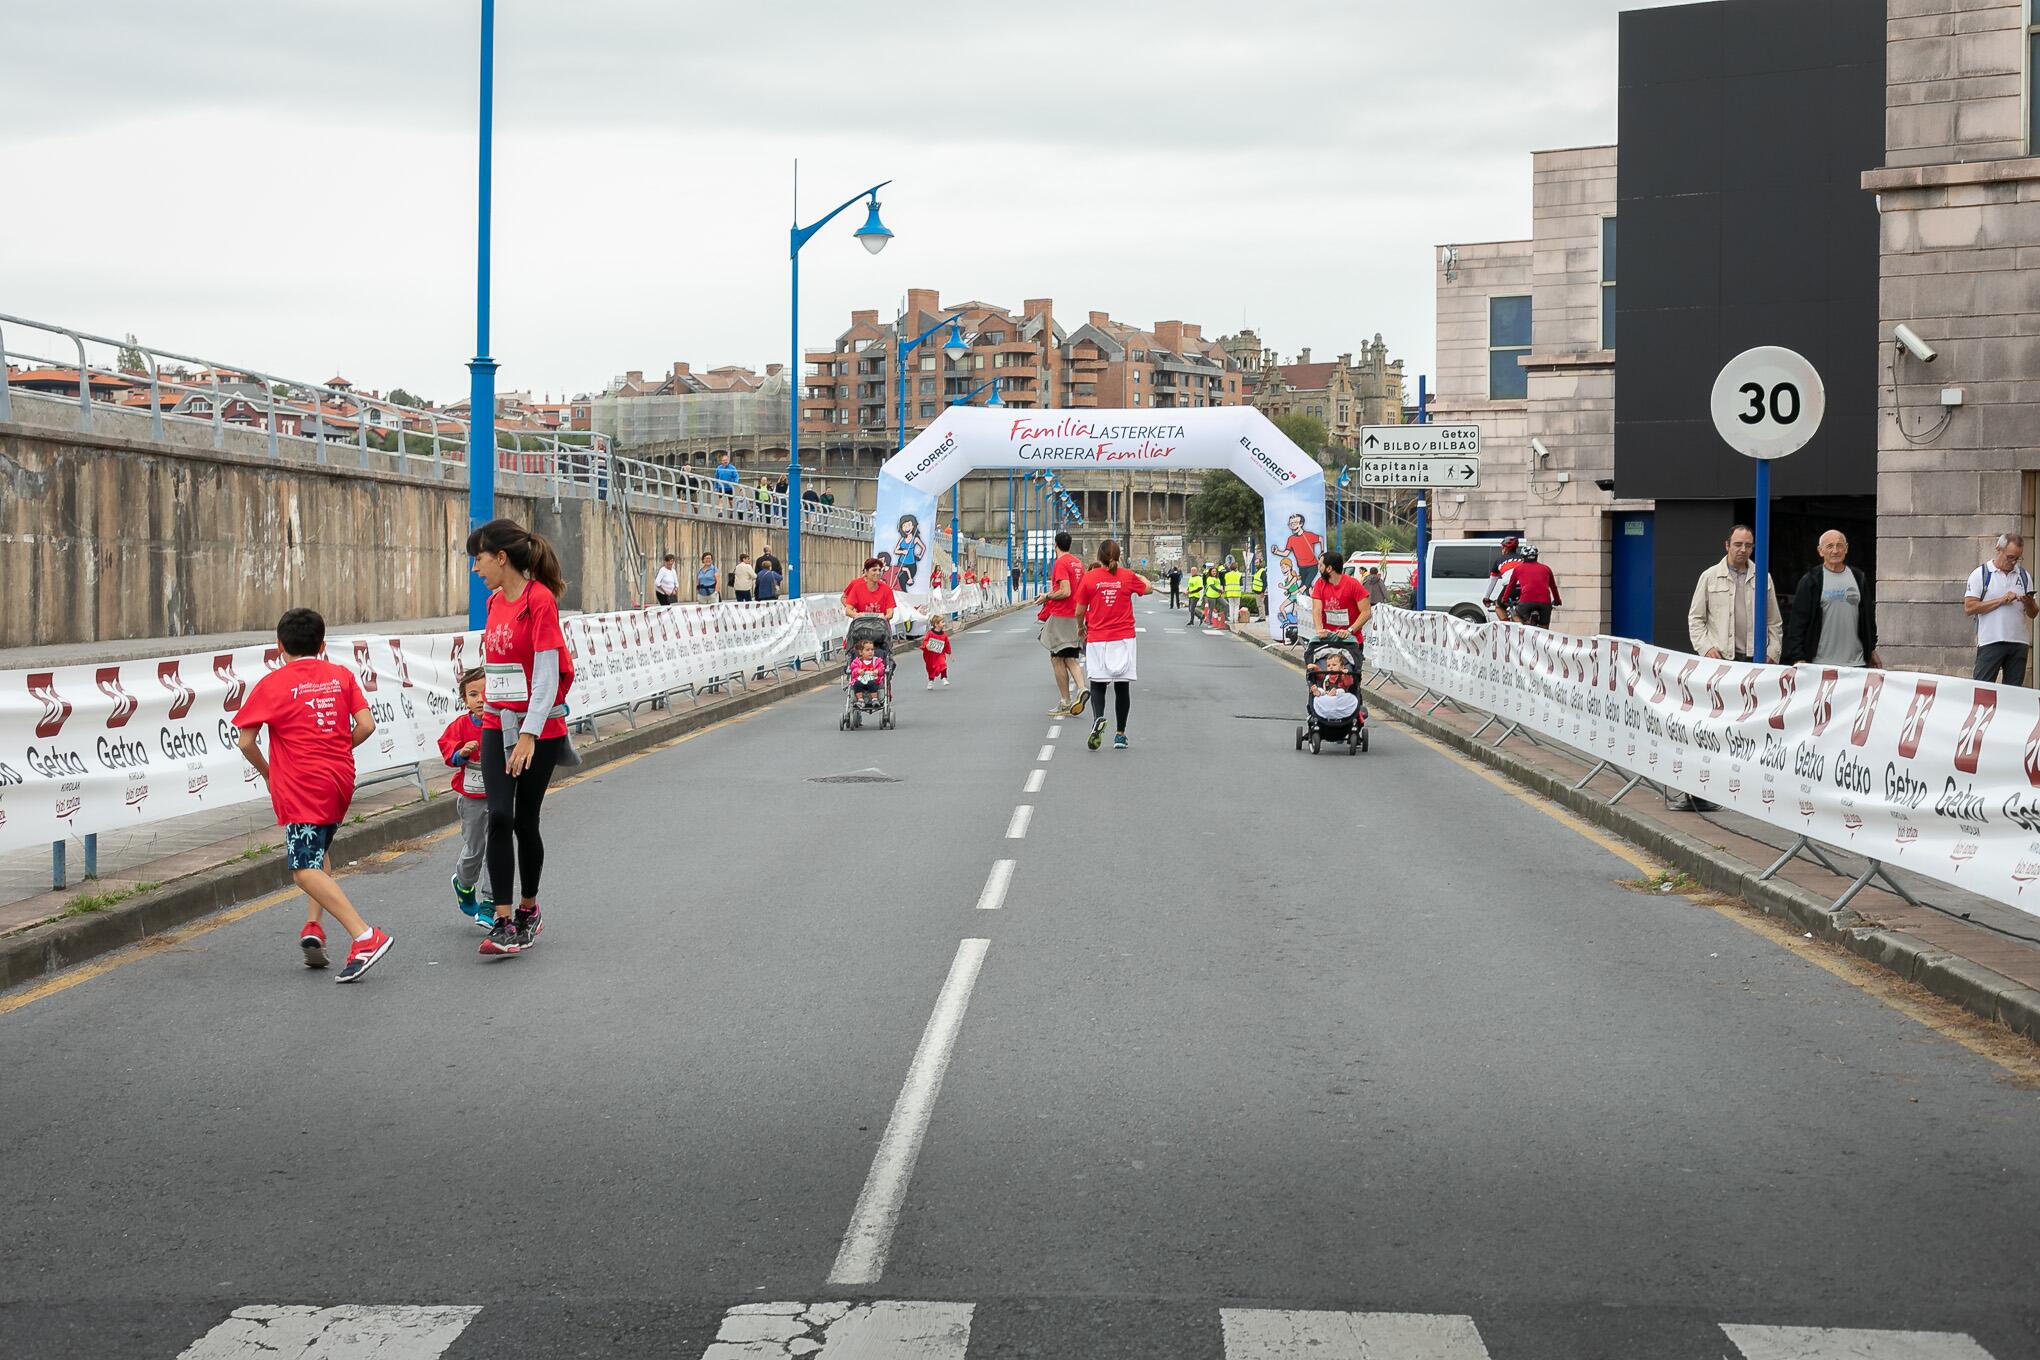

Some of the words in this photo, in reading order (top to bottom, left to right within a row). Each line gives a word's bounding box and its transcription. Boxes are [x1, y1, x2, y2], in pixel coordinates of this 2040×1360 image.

[1738, 382, 1800, 424] 30
[1010, 417, 1091, 440] Familia
[1090, 424, 1185, 439] LASTERKETA
[1442, 430, 1476, 439] Getxo
[904, 471, 919, 482] EL
[917, 438, 954, 472] CORREO
[1018, 444, 1096, 460] CARRERA
[1096, 441, 1176, 461] Familiar
[1240, 436, 1251, 450] EL
[1251, 447, 1290, 481] CORREO
[1383, 442, 1476, 451] BILBO/BILBAO
[1364, 461, 1429, 472] Kapitania
[160, 726, 208, 760] Getxo
[1665, 712, 1689, 746] Getxo
[1692, 719, 1721, 754] Getxo
[1725, 726, 1756, 762] Getxo
[26, 745, 89, 778] Getxo
[96, 735, 150, 770] Getxo
[1794, 740, 1825, 782] Getxo
[1834, 749, 1871, 796] Getxo
[1884, 761, 1928, 810] Getxo
[1934, 776, 1990, 824] Getxo
